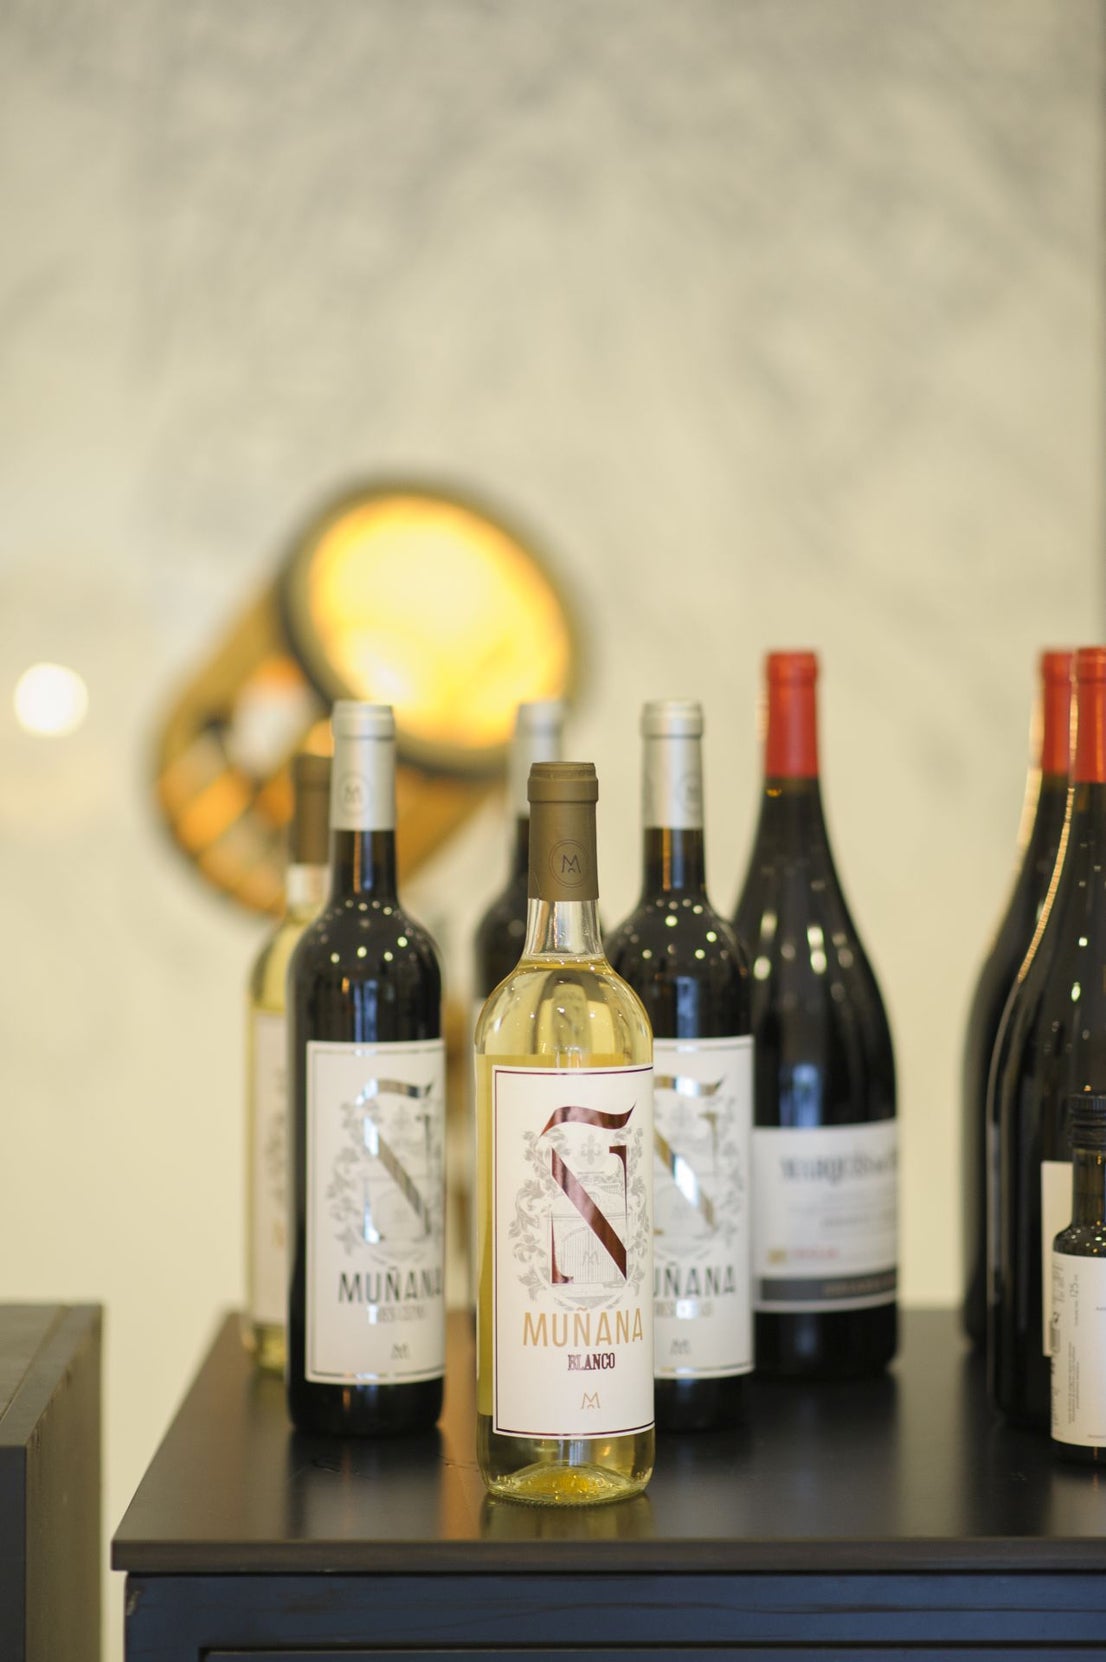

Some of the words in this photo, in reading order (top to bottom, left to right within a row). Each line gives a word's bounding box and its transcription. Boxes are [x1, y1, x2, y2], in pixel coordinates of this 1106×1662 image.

[538, 1101, 637, 1284] Ñ
[522, 1306, 644, 1348] MUÑANA
[567, 1352, 616, 1371] BLANCO
